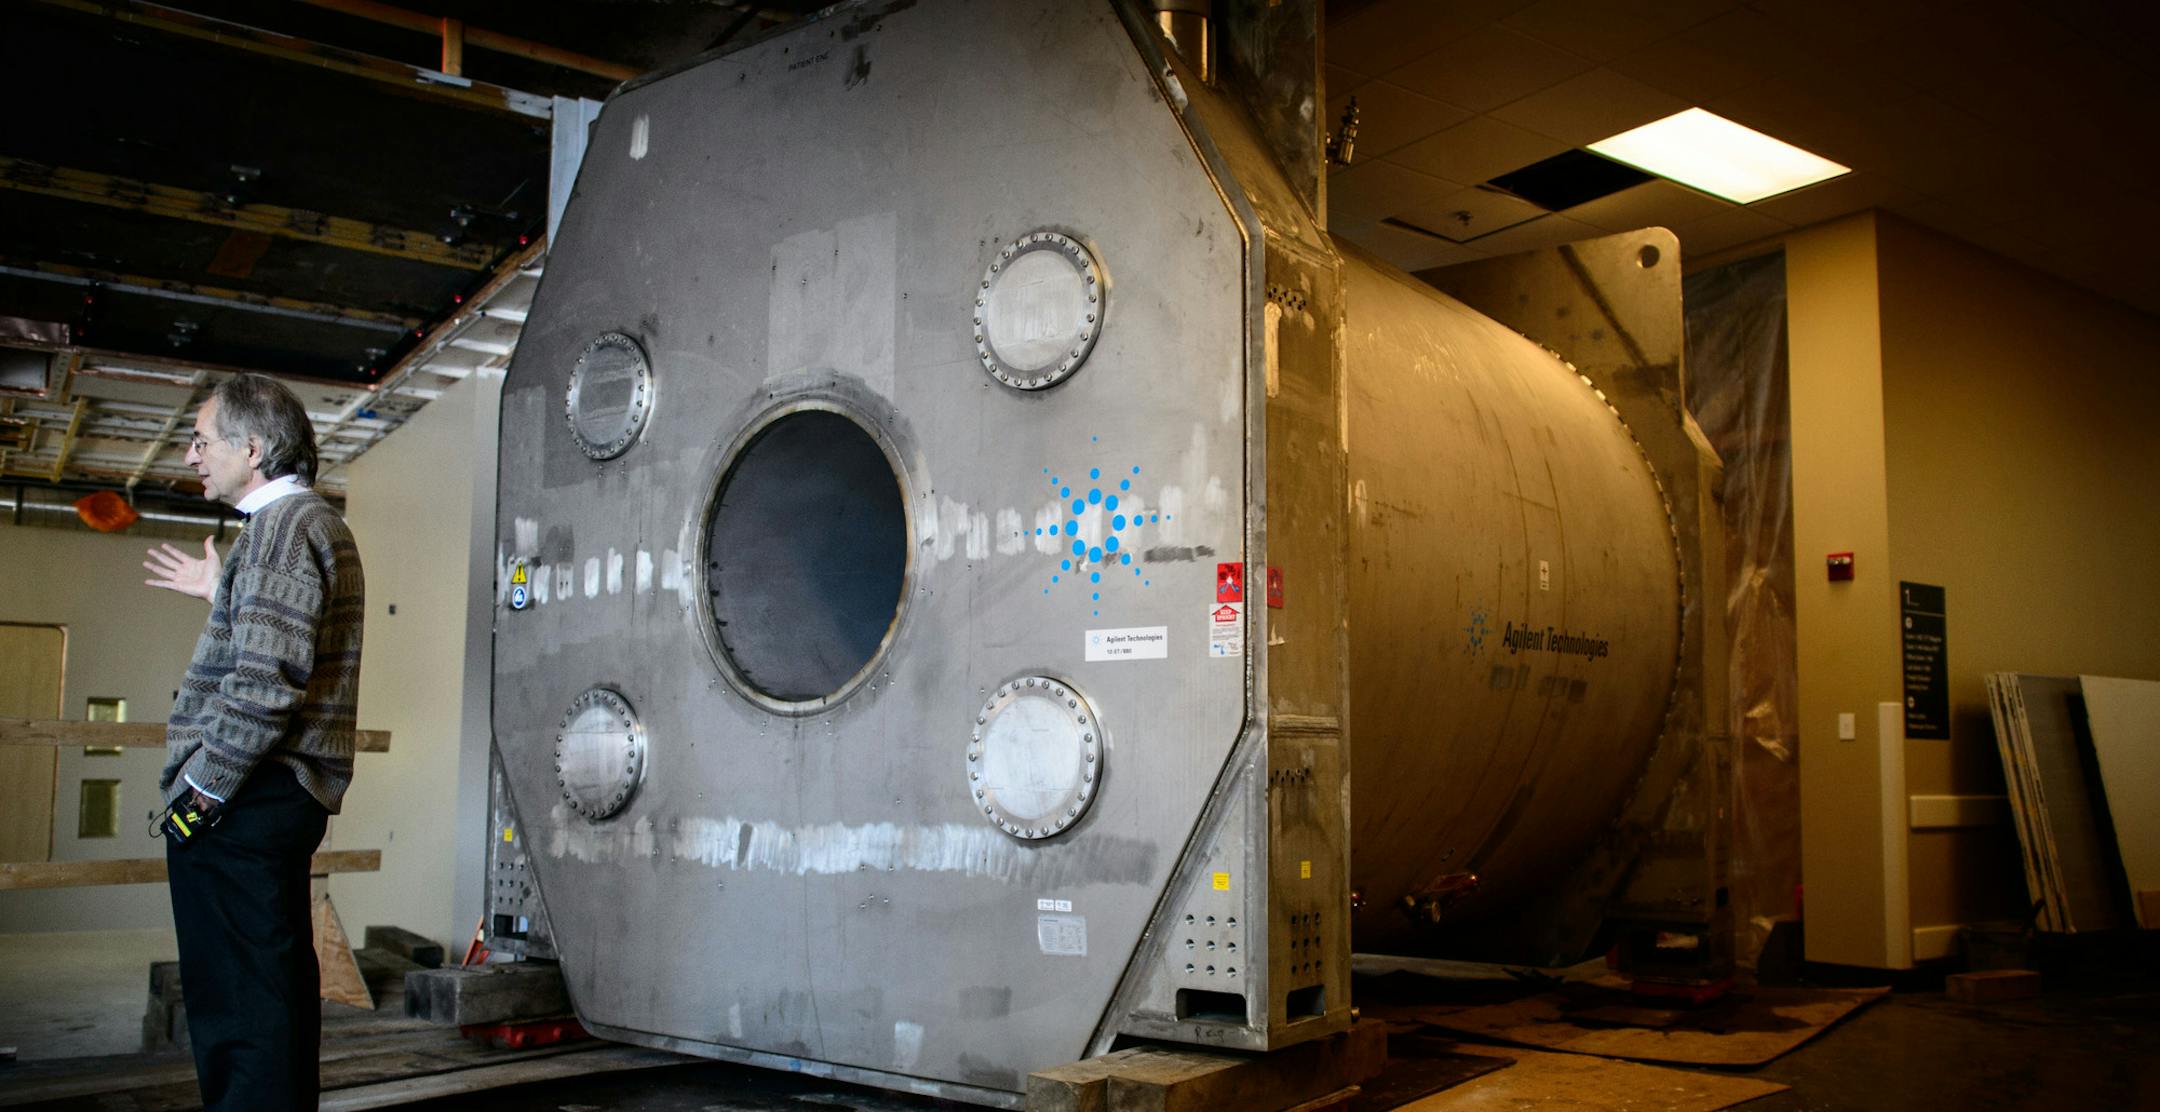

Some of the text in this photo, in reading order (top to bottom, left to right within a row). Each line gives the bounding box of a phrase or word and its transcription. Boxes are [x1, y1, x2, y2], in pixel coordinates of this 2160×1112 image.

[1106, 634, 1163, 644] Agilent Technologies
[1502, 621, 1608, 662] Agilent Technologies
